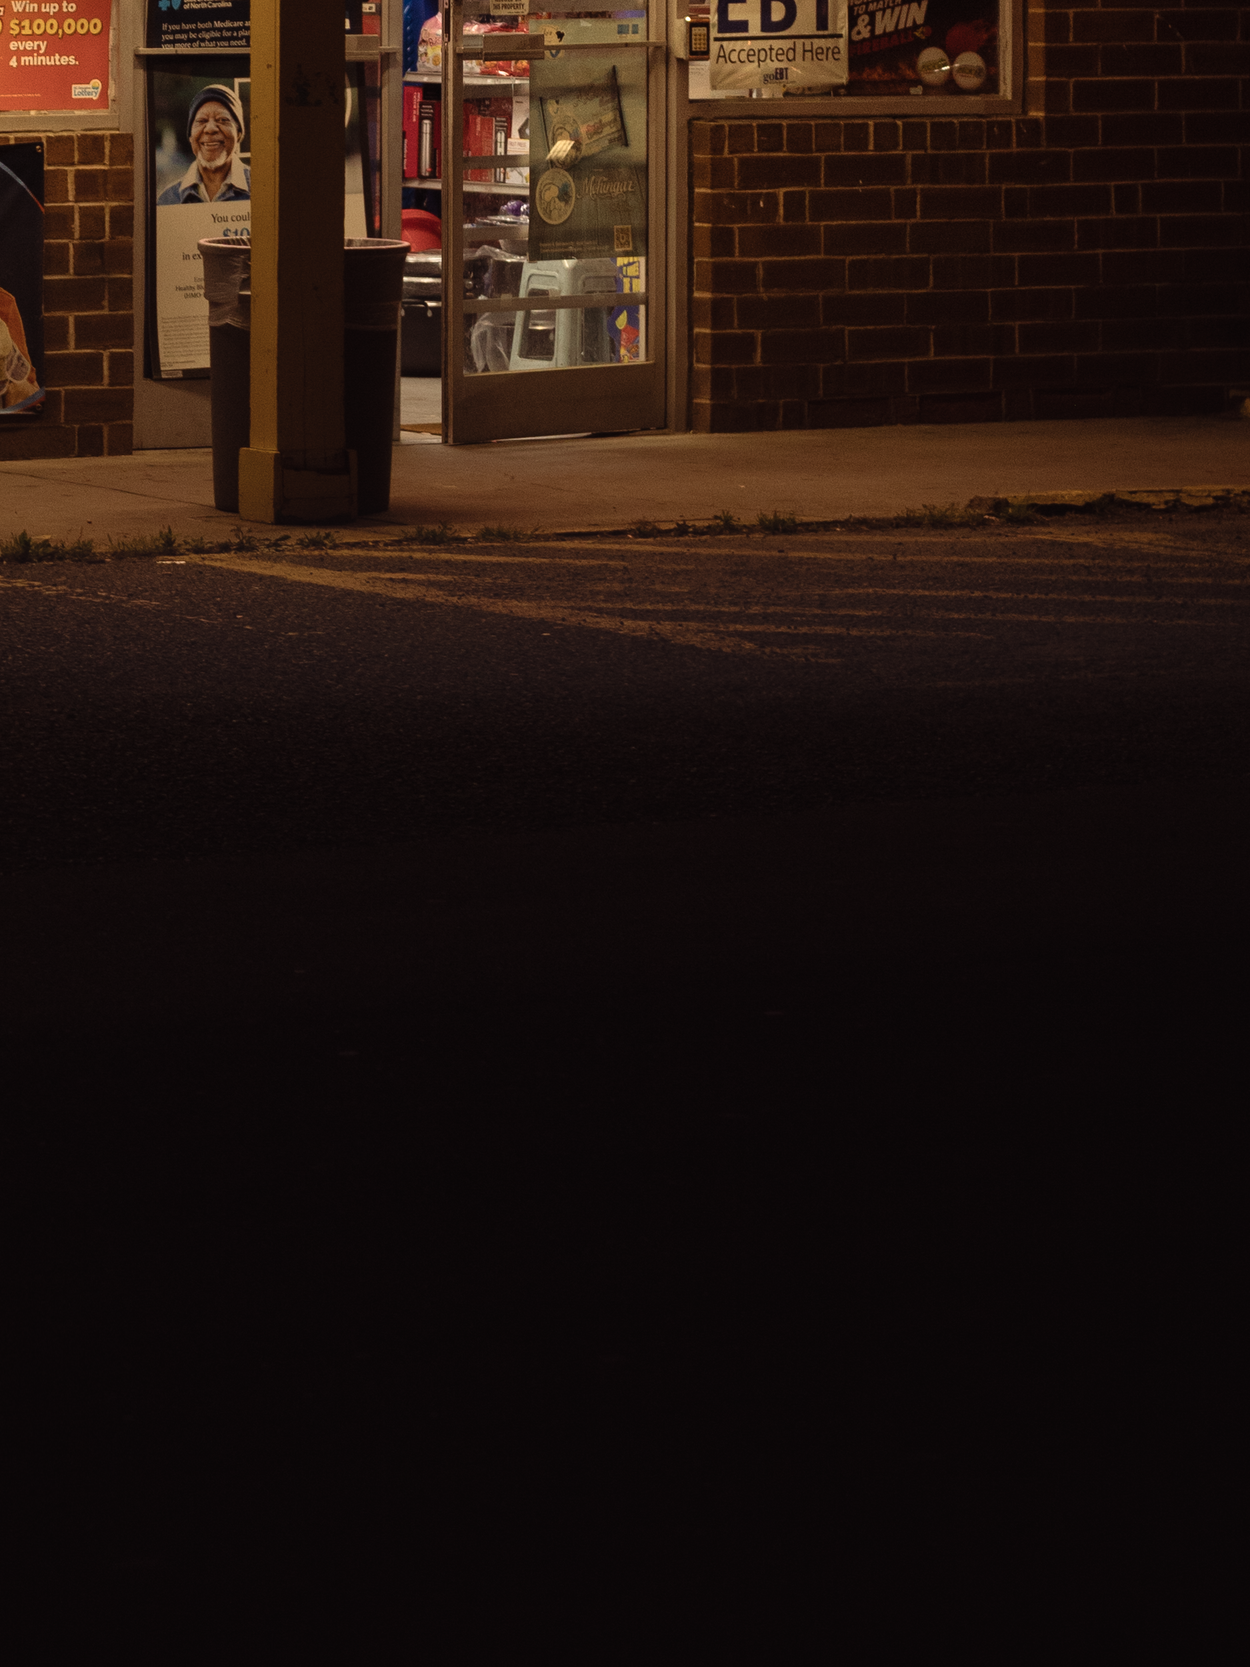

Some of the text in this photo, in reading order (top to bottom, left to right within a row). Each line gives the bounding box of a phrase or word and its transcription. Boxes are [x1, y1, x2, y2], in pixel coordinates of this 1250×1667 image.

[11, 1, 77, 16] Win up to
[853, 5, 867, 15] TO
[197, 21, 212, 29] both
[213, 20, 243, 28] Medicare
[850, 0, 929, 41] & WIN
[9, 18, 102, 38] $100,000
[198, 31, 221, 39] eligible
[9, 41, 47, 54] every
[9, 53, 79, 67] 4 minutes.
[716, 41, 841, 68] Accepted Here
[211, 213, 229, 223] You
[182, 252, 191, 260] in
